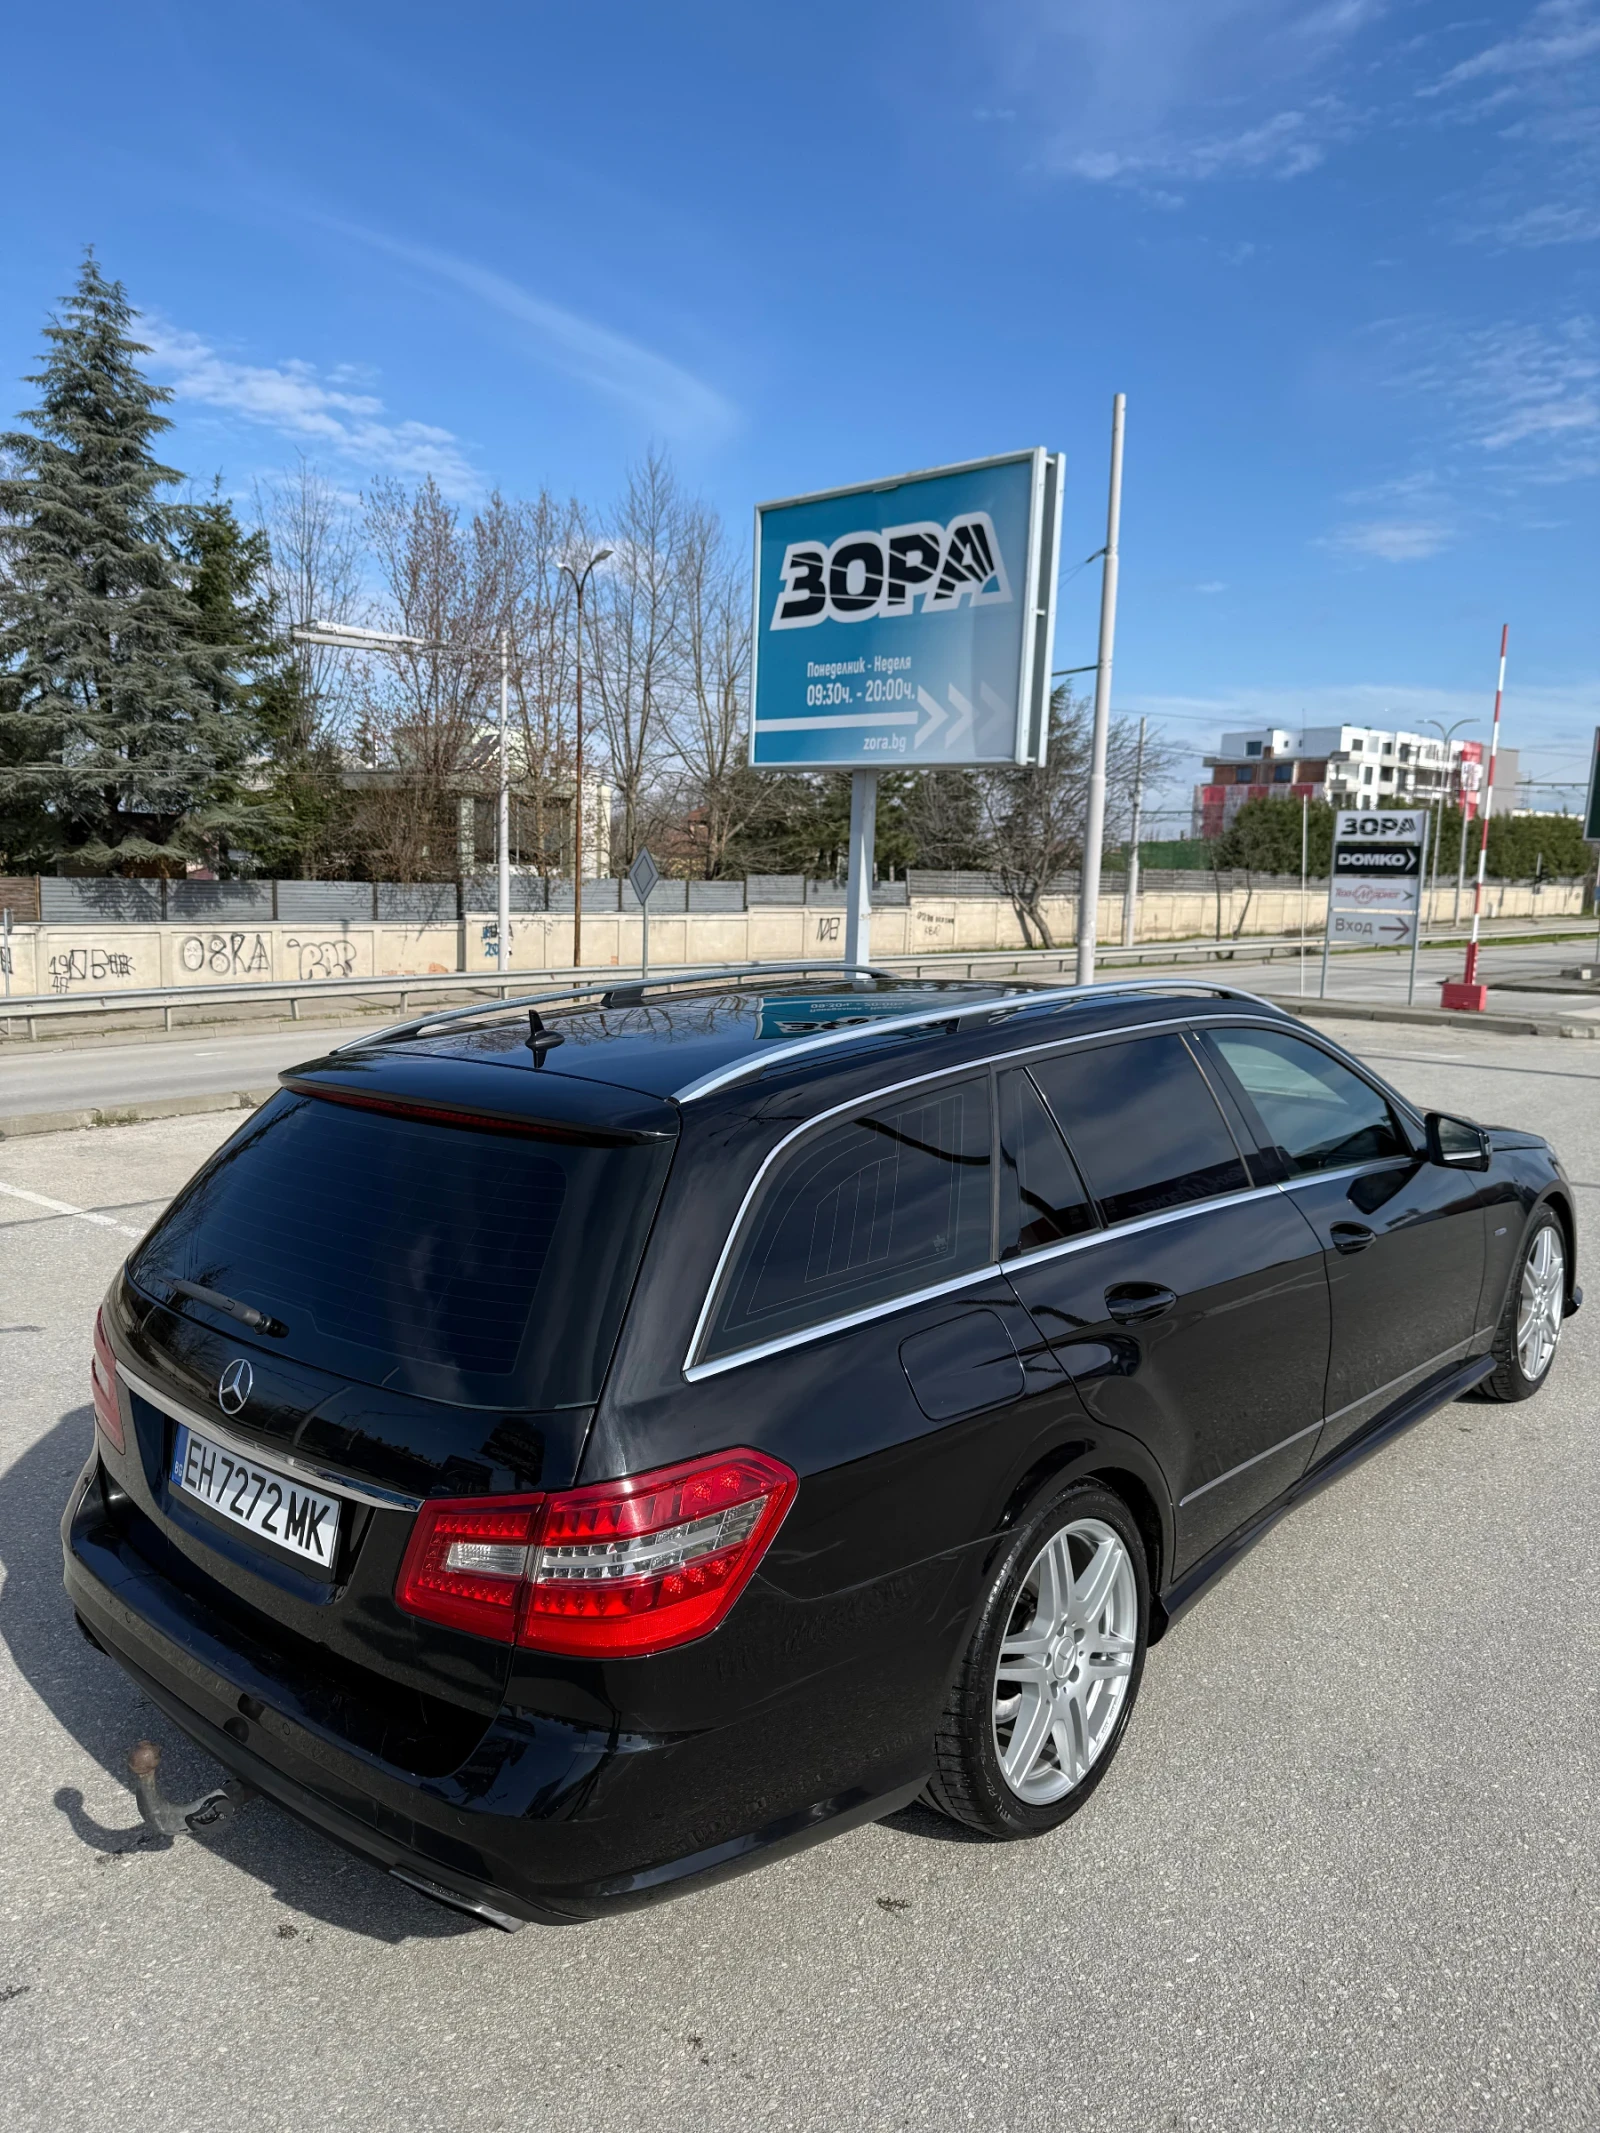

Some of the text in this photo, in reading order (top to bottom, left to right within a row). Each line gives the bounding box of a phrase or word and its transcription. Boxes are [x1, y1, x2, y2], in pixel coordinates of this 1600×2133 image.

[770, 512, 1013, 631] ЗОРА
[807, 657, 866, 679] Понеделник
[874, 656, 912, 675] Неделя
[807, 683, 853, 706] 09:30ч.
[865, 678, 915, 702] 20:00ч.
[863, 733, 906, 752] zora.bg
[1341, 818, 1416, 836] ЗОРА
[1338, 853, 1406, 866] DOMKO
[1335, 918, 1373, 935] Вход
[174, 1460, 183, 1477] BG
